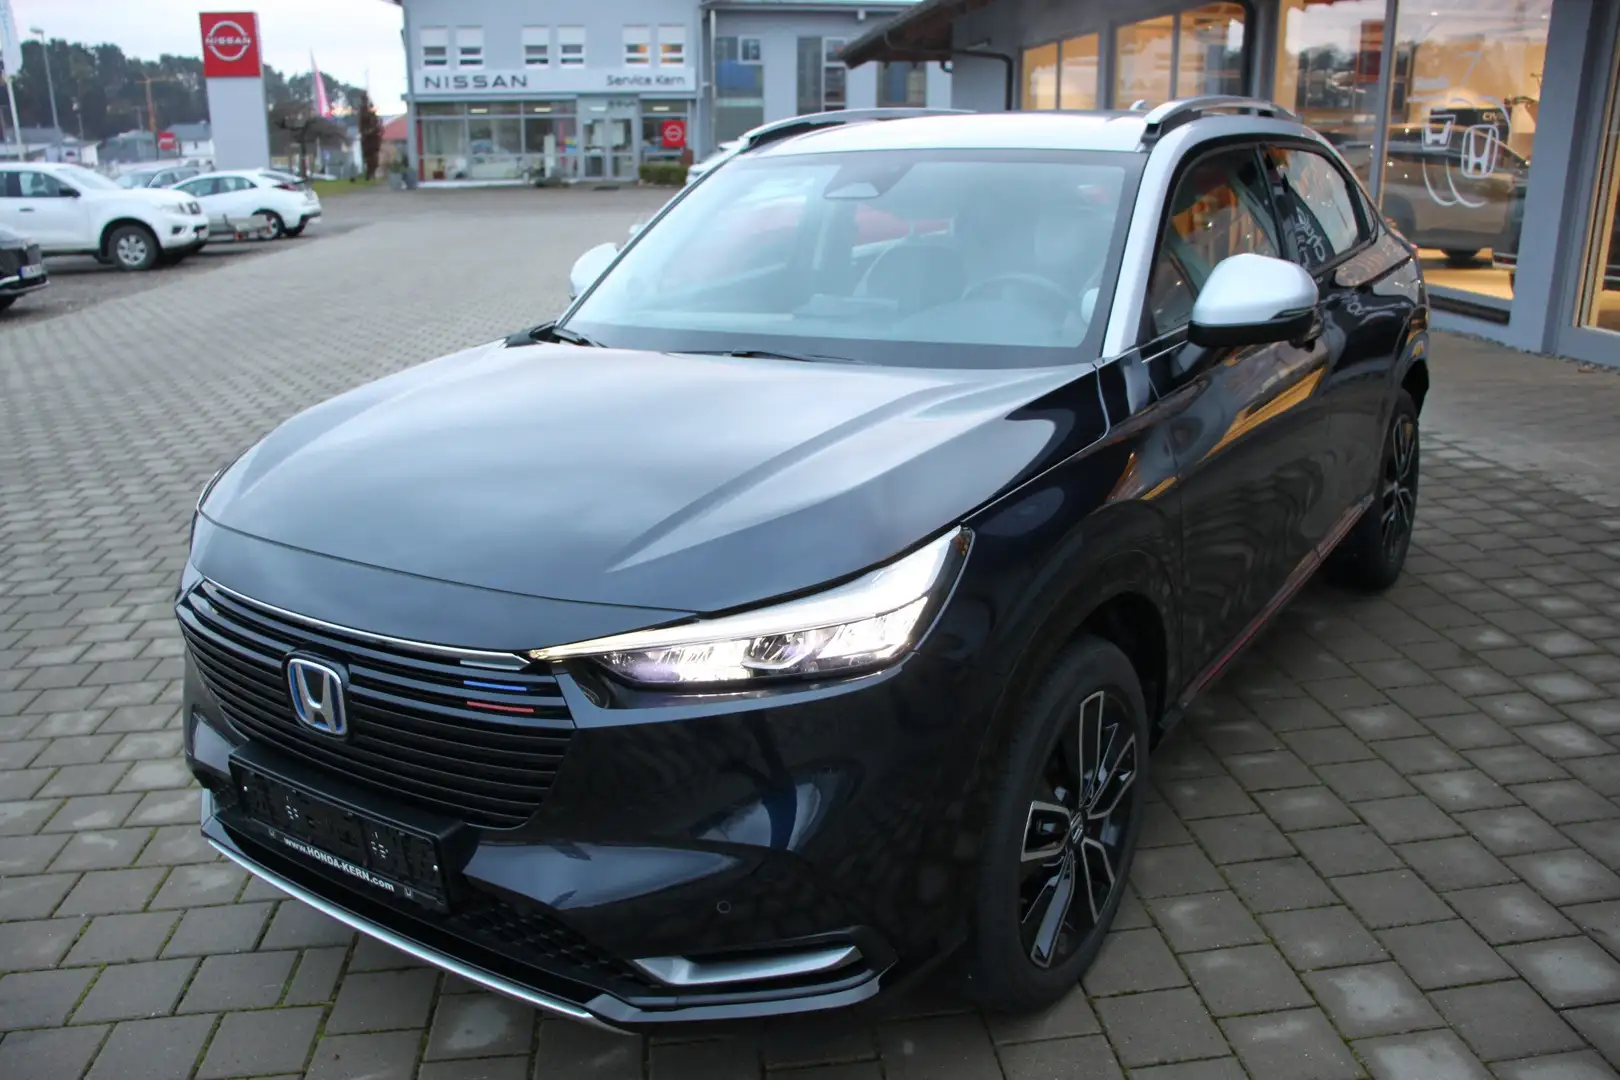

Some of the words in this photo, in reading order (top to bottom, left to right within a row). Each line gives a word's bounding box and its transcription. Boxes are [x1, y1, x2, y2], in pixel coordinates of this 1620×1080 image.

[205, 36, 251, 45] NISSAN
[424, 74, 528, 89] NISSAN
[606, 74, 651, 86] Service
[655, 75, 686, 85] Kern
[283, 837, 396, 892] www.HONDA-KERN.com
